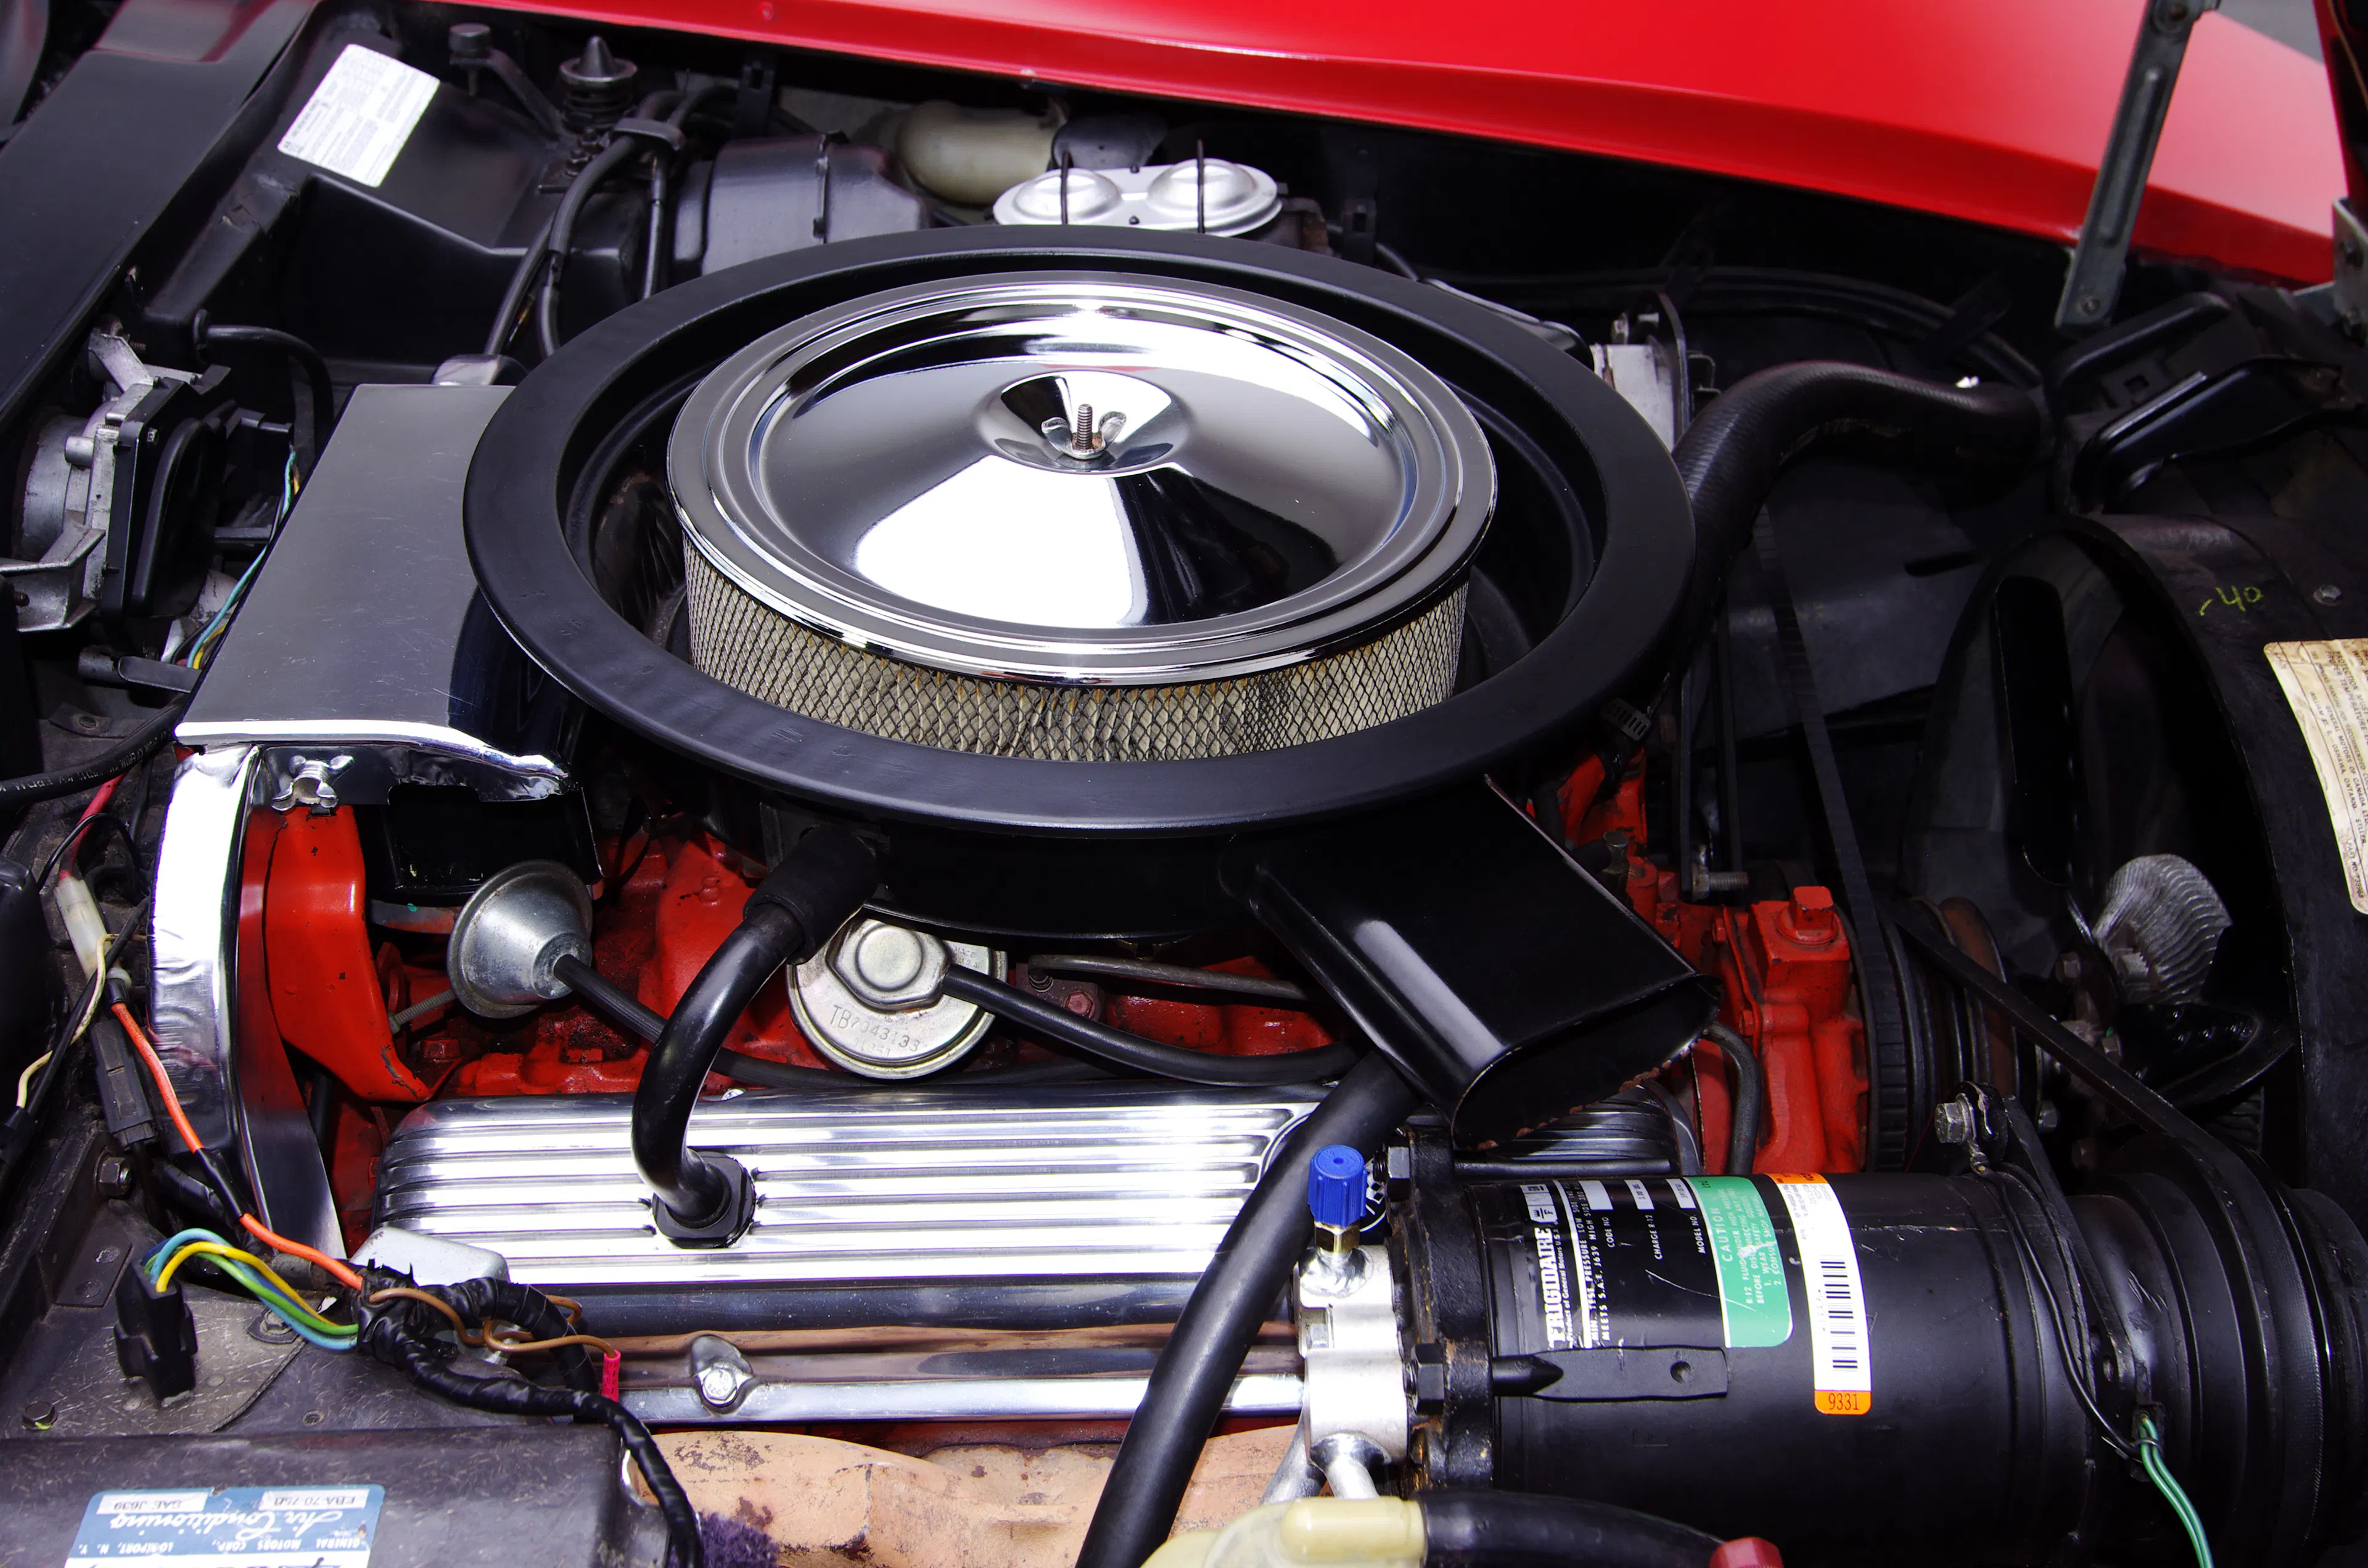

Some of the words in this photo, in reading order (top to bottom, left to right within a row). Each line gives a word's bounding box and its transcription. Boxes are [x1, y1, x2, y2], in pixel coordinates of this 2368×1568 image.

[2335, 651, 2358, 691] PROTECTION
[2326, 651, 2342, 676] PROPER
[2340, 679, 2367, 731] TEMPERATURE
[2325, 705, 2341, 732] GENERAL
[2338, 735, 2353, 763] MOTORS
[2350, 766, 2356, 774] OF
[2353, 778, 2366, 807] CANADA
[2346, 724, 2366, 770] RECOMMENDED
[2344, 778, 2357, 809] ONTARIO
[1571, 1202, 1581, 1213] SIDE
[1581, 1203, 1592, 1217] SIDE
[1727, 1212, 1738, 1226] HIGH
[1575, 1218, 1585, 1233] LOW
[1586, 1220, 1597, 1240] HIGH
[1709, 1208, 1733, 1262] CAUTION
[1759, 1219, 1772, 1238] SHOP
[1605, 1229, 1616, 1249] CODE
[1650, 1230, 1663, 1260] CHARGE
[1693, 1228, 1706, 1254] MODEL
[1557, 1247, 1566, 1270] Motors
[1579, 1239, 1593, 1282] PRESSURE
[1590, 1246, 1602, 1268] J639
[1759, 1252, 1769, 1275] WEAR
[1739, 1258, 1749, 1281] FLUID
[1534, 1227, 1566, 1350] FRIGIDAIRE
[1560, 1270, 1570, 1299] General
[1753, 1275, 1764, 1304] BEFORE
[1563, 1300, 1571, 1309] of
[1587, 1288, 1597, 1310] TEST
[1564, 1310, 1574, 1342] Product
[1598, 1304, 1611, 1342] MEETS
[1828, 1392, 1860, 1411] 9331
[110, 1511, 282, 1541] Conditioning
[284, 1511, 343, 1538] Air
[257, 1538, 302, 1551] MOTORS
[315, 1538, 361, 1550] GENERAL
